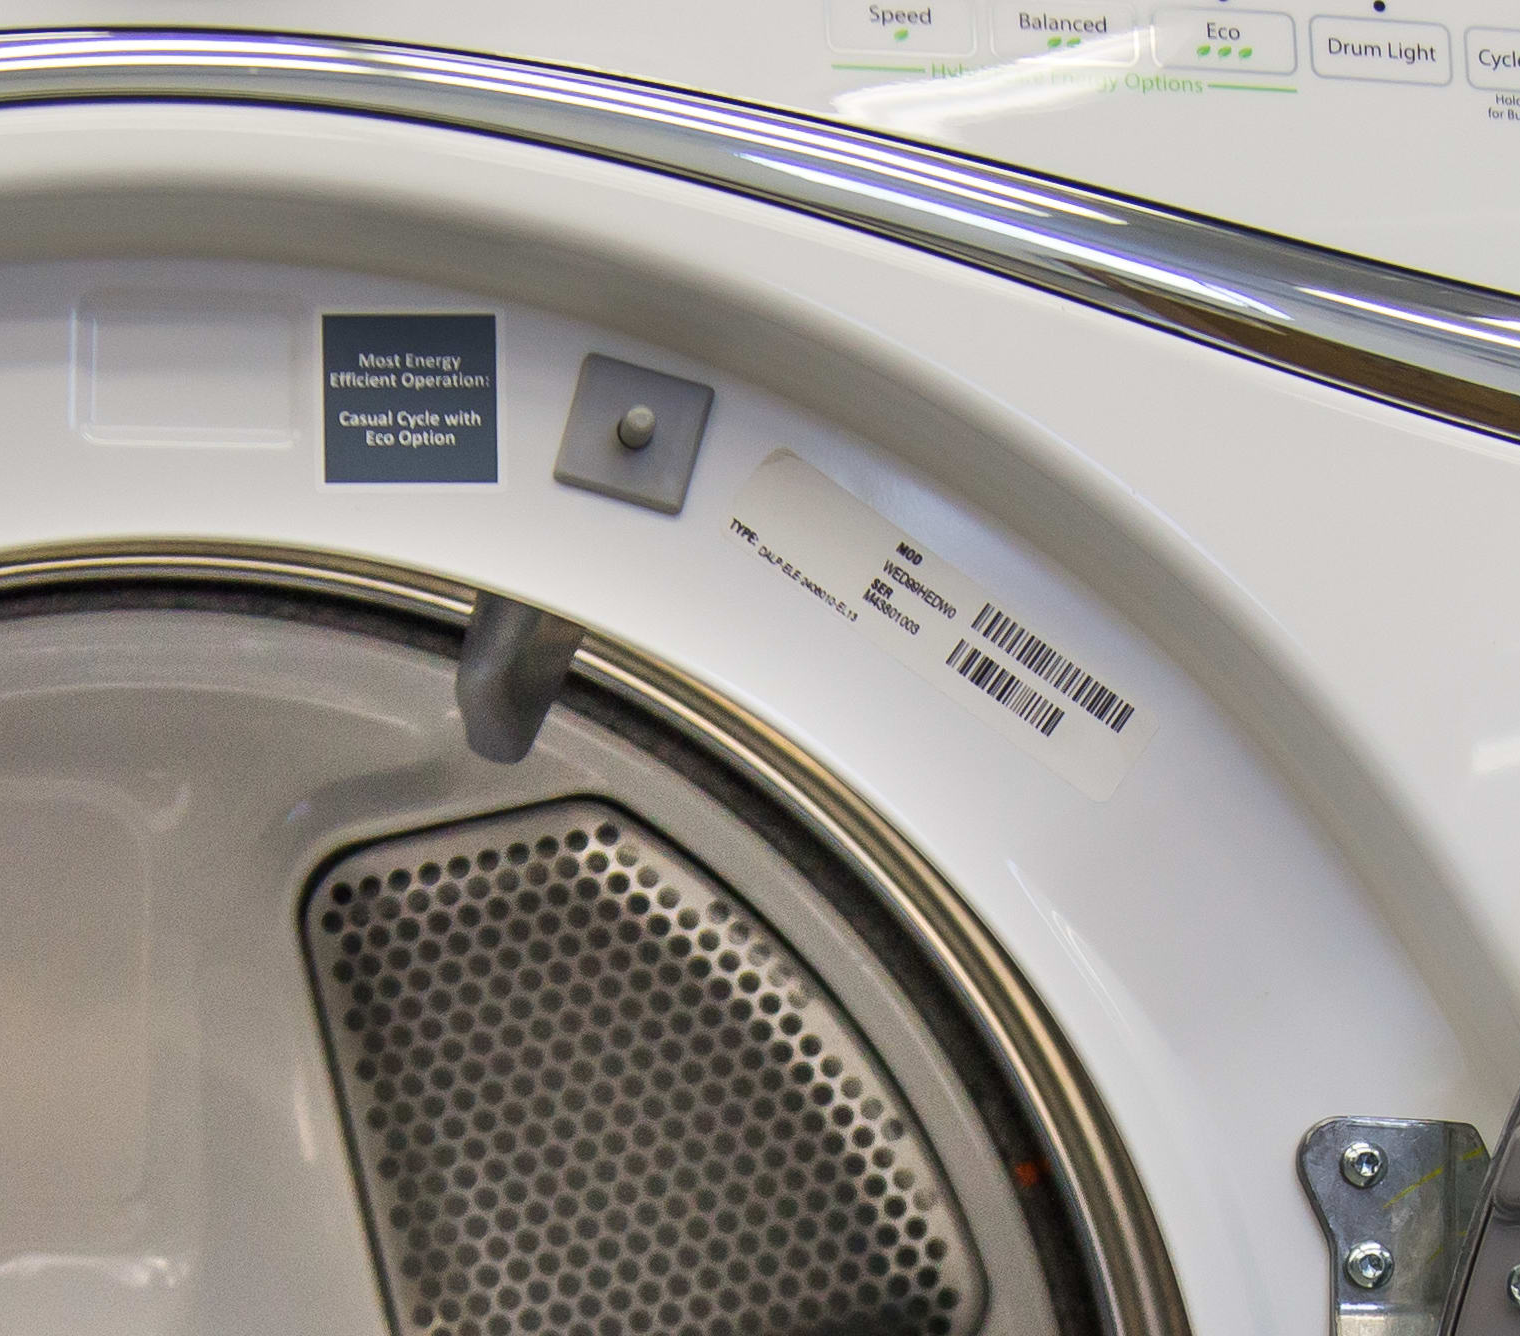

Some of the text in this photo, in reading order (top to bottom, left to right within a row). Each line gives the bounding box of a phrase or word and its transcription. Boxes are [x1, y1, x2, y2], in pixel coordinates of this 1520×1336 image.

[869, 4, 932, 26] Speed
[1019, 12, 1108, 34] Balanced
[1206, 22, 1241, 41] Eco
[1328, 37, 1437, 64] Drum Light
[1125, 72, 1204, 94] Options
[1488, 107, 1504, 119] for
[358, 353, 461, 371] Most Energy
[329, 372, 491, 390] Efficient Operation:
[338, 409, 482, 429] Casual Cycle with
[365, 429, 456, 448] Eco Option
[729, 517, 759, 546] TYPE:
[896, 541, 923, 565] MOD
[871, 578, 894, 599] SER
